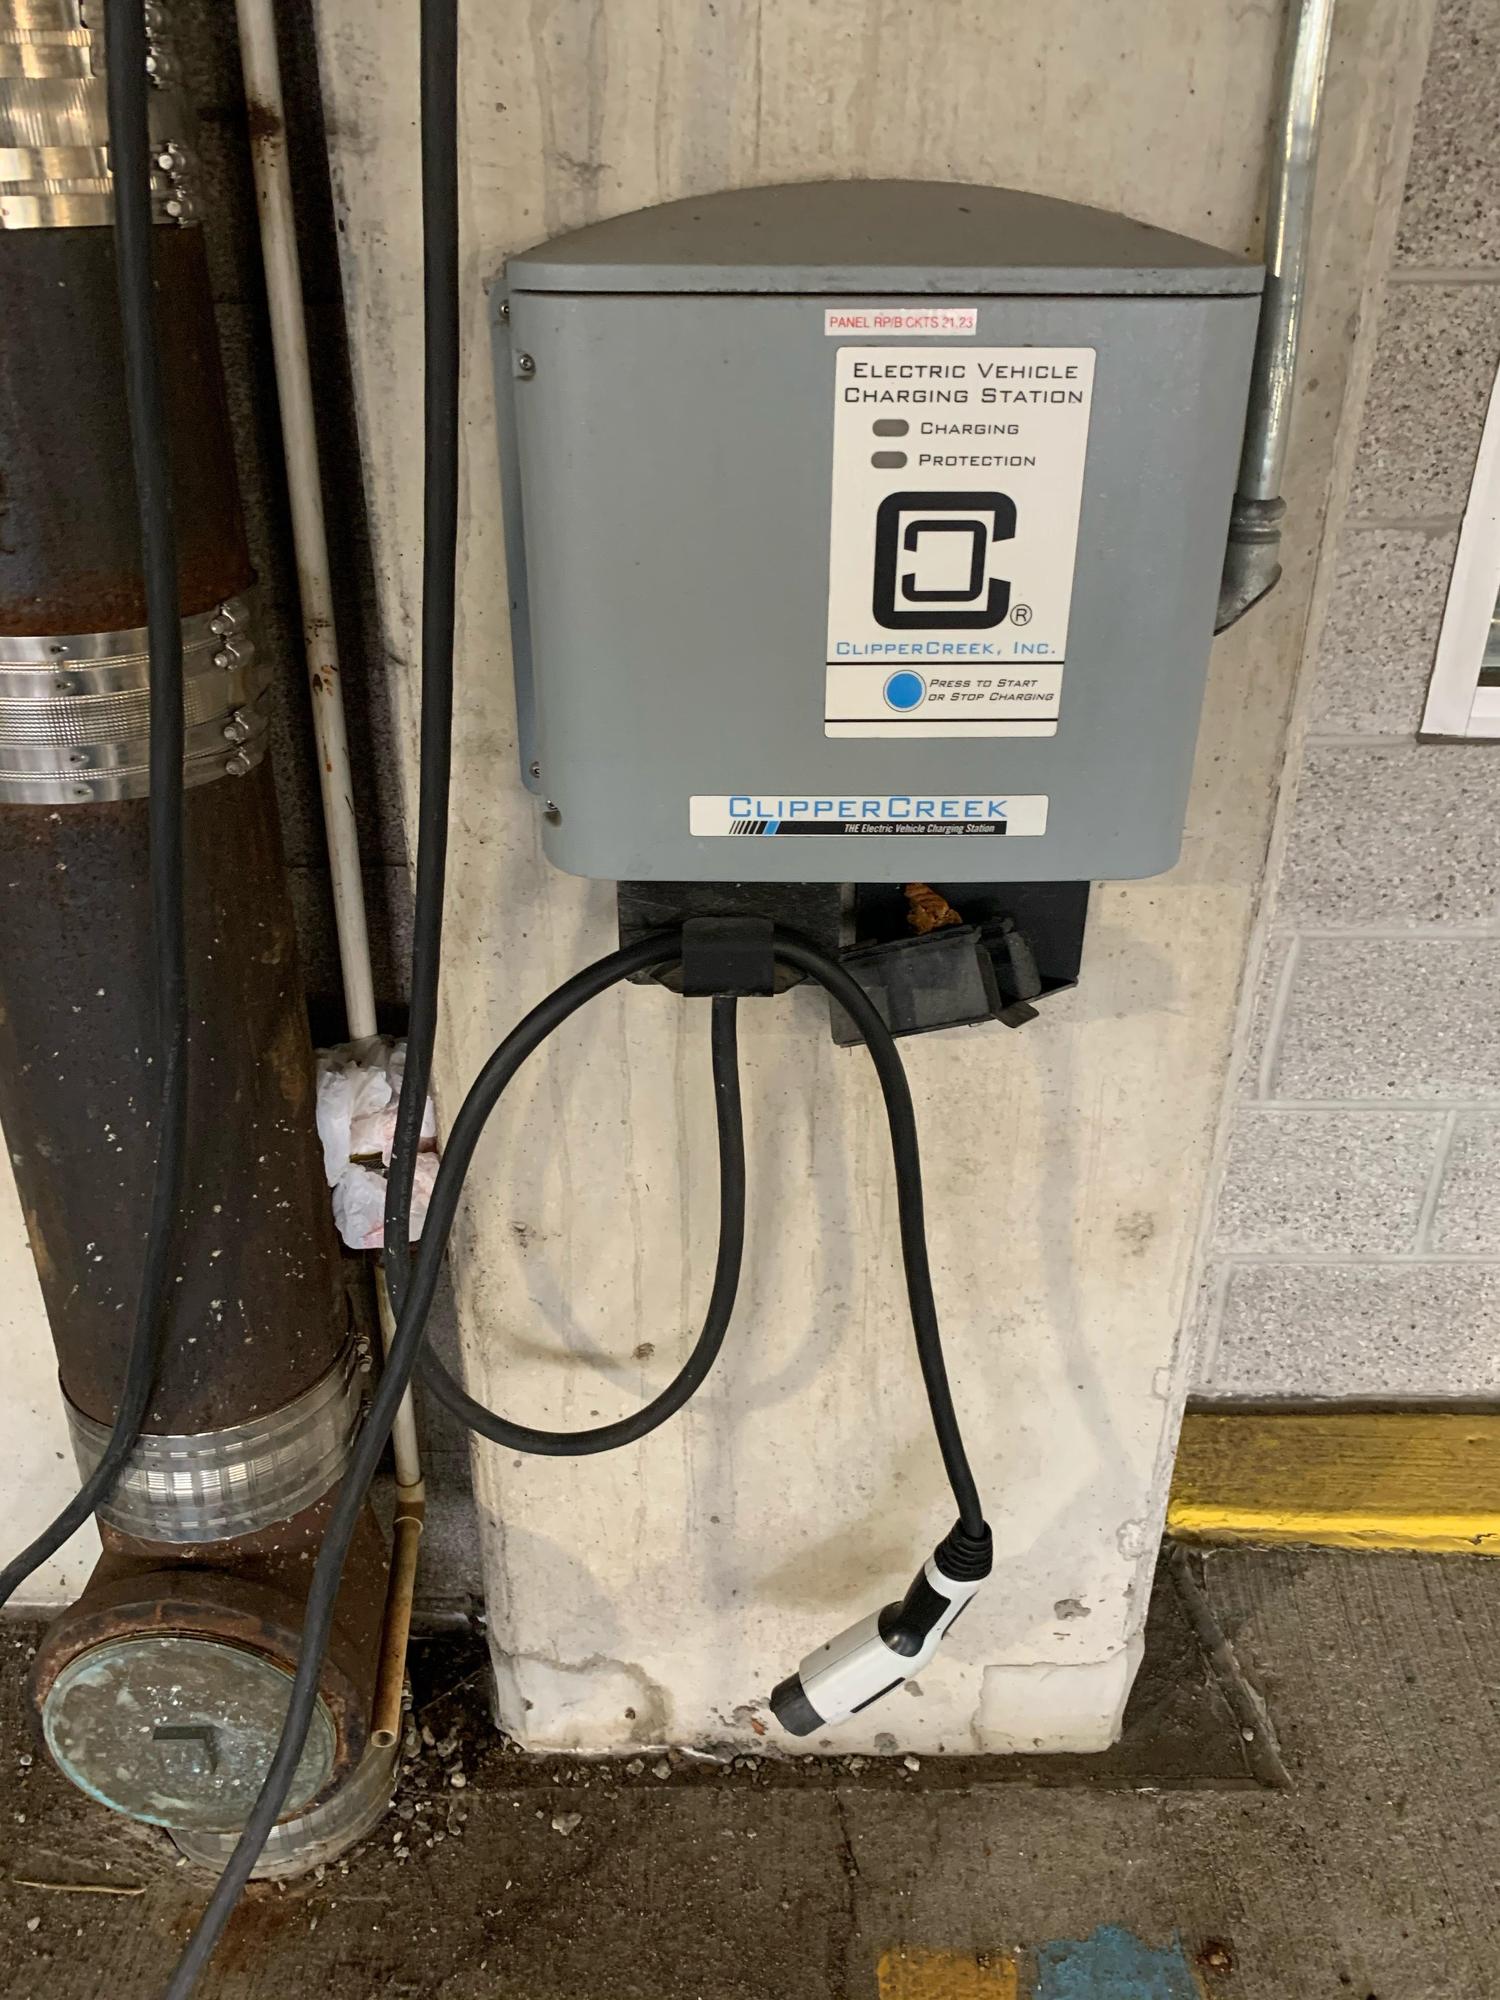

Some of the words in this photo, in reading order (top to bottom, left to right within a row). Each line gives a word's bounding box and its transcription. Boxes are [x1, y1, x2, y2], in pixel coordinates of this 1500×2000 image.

[829, 316, 869, 328] PANEL
[905, 316, 938, 328] CKTS
[853, 362, 966, 379] ELECTRIC
[977, 362, 1078, 379] VEHICLE
[844, 387, 968, 403] CHARGING
[980, 388, 1083, 404] STATION
[920, 422, 1019, 435] CHARGING
[918, 454, 1036, 467] PROTECTION
[836, 642, 1001, 656] CLIPPERCREEK,
[1013, 642, 1056, 655] INC.
[929, 679, 971, 688] PRESS
[976, 679, 992, 688] TO
[996, 679, 1038, 688] START
[928, 693, 945, 702] OR
[950, 692, 984, 702] STOP
[989, 692, 1054, 701] CHARGING
[729, 797, 1008, 818] CLIPPERCREEK
[844, 823, 860, 833] THE
[861, 823, 894, 833] Electric
[896, 823, 925, 833] Vehicle
[926, 823, 964, 835] Charging
[965, 823, 995, 833] Station
